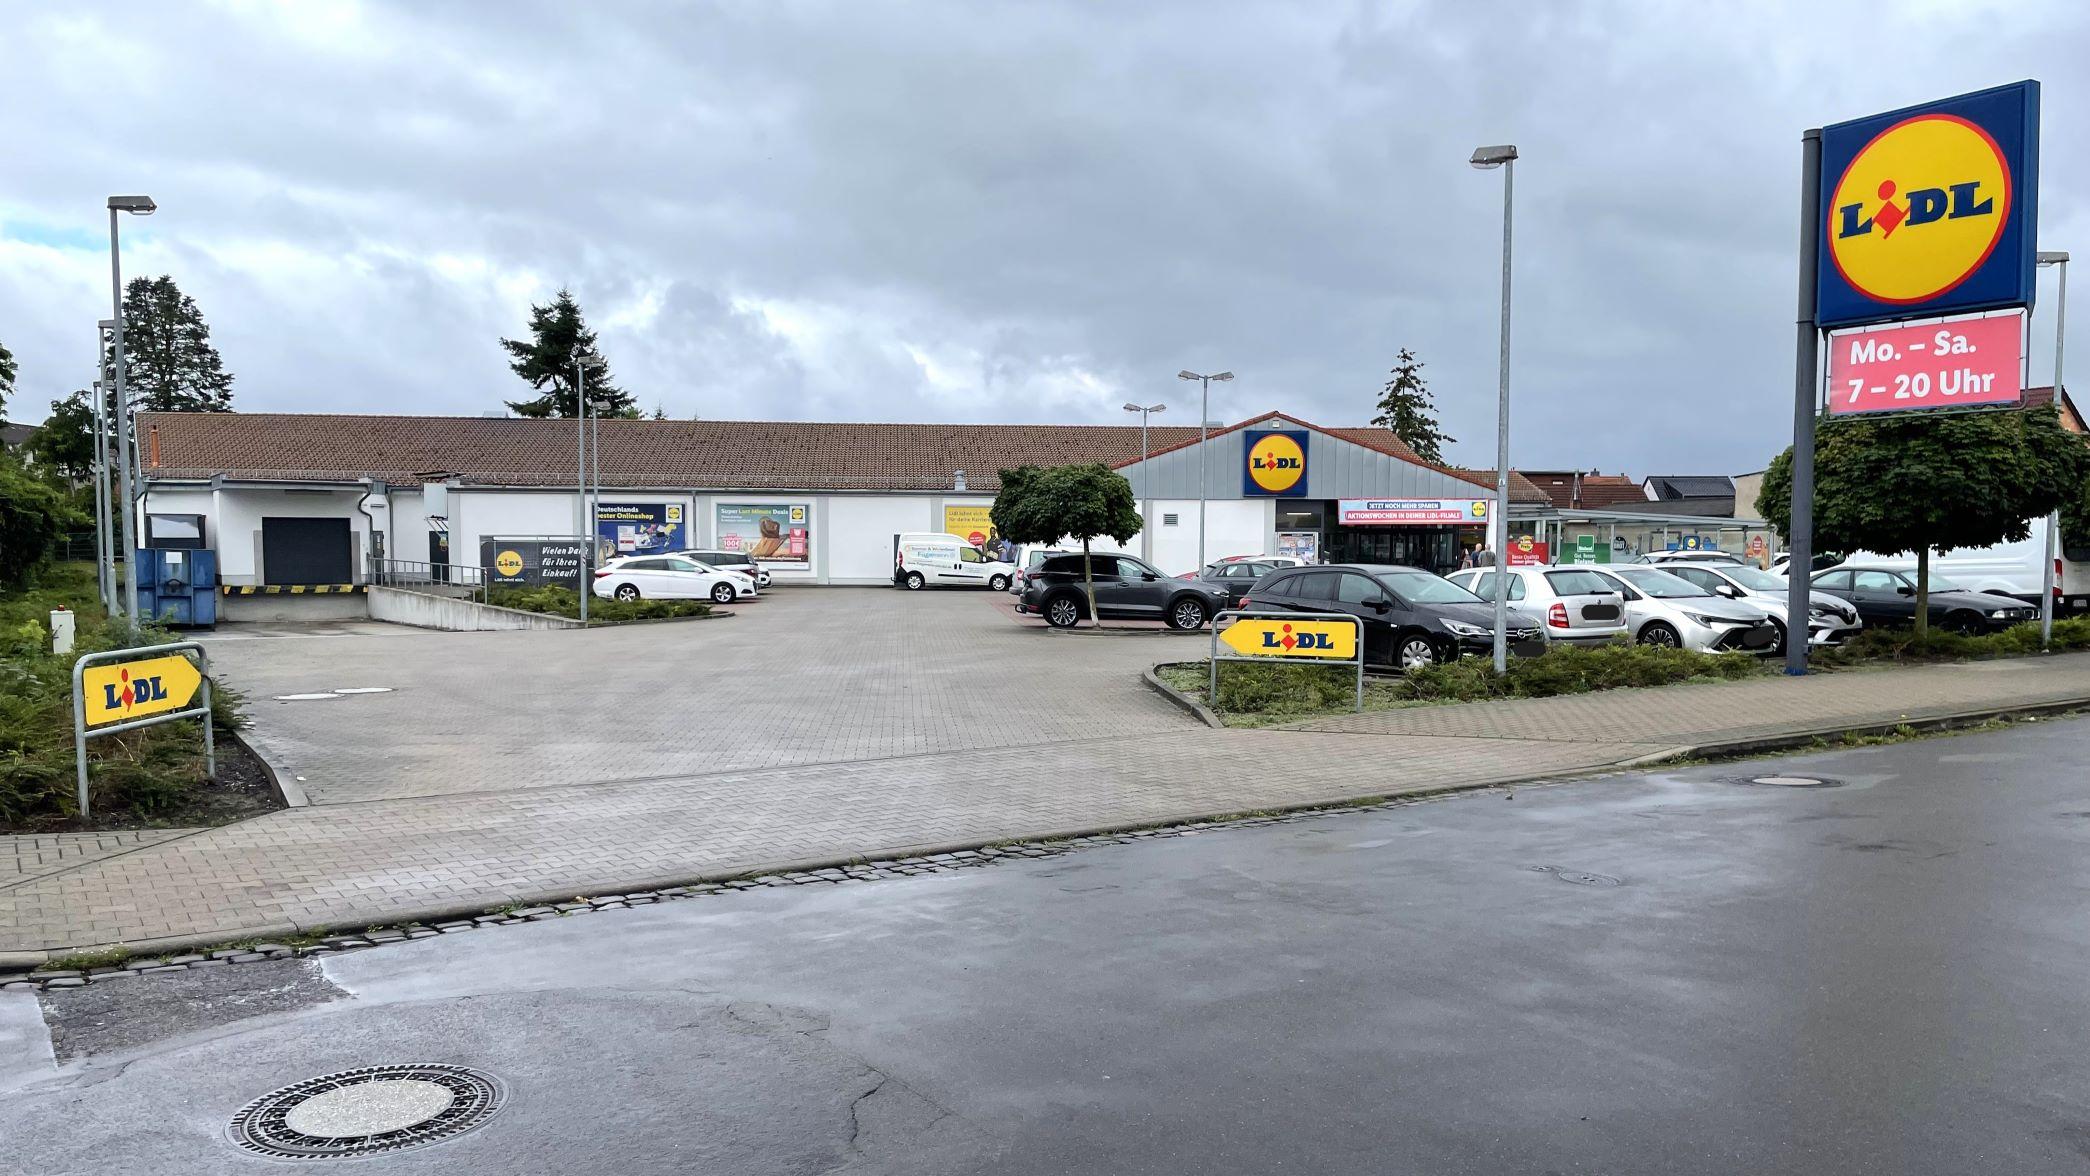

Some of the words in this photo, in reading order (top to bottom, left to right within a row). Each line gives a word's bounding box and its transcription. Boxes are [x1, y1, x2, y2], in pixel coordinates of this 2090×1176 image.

[1850, 339, 1902, 365] Mo.
[1934, 331, 1977, 356] Sa.
[1849, 379, 1864, 403] 7
[1894, 374, 1931, 399] 20
[1939, 369, 1995, 395] Uhr
[541, 547, 566, 555] Vielen
[542, 558, 553, 567] für
[555, 558, 577, 566] Ihren
[542, 569, 577, 578] Einkauf!
